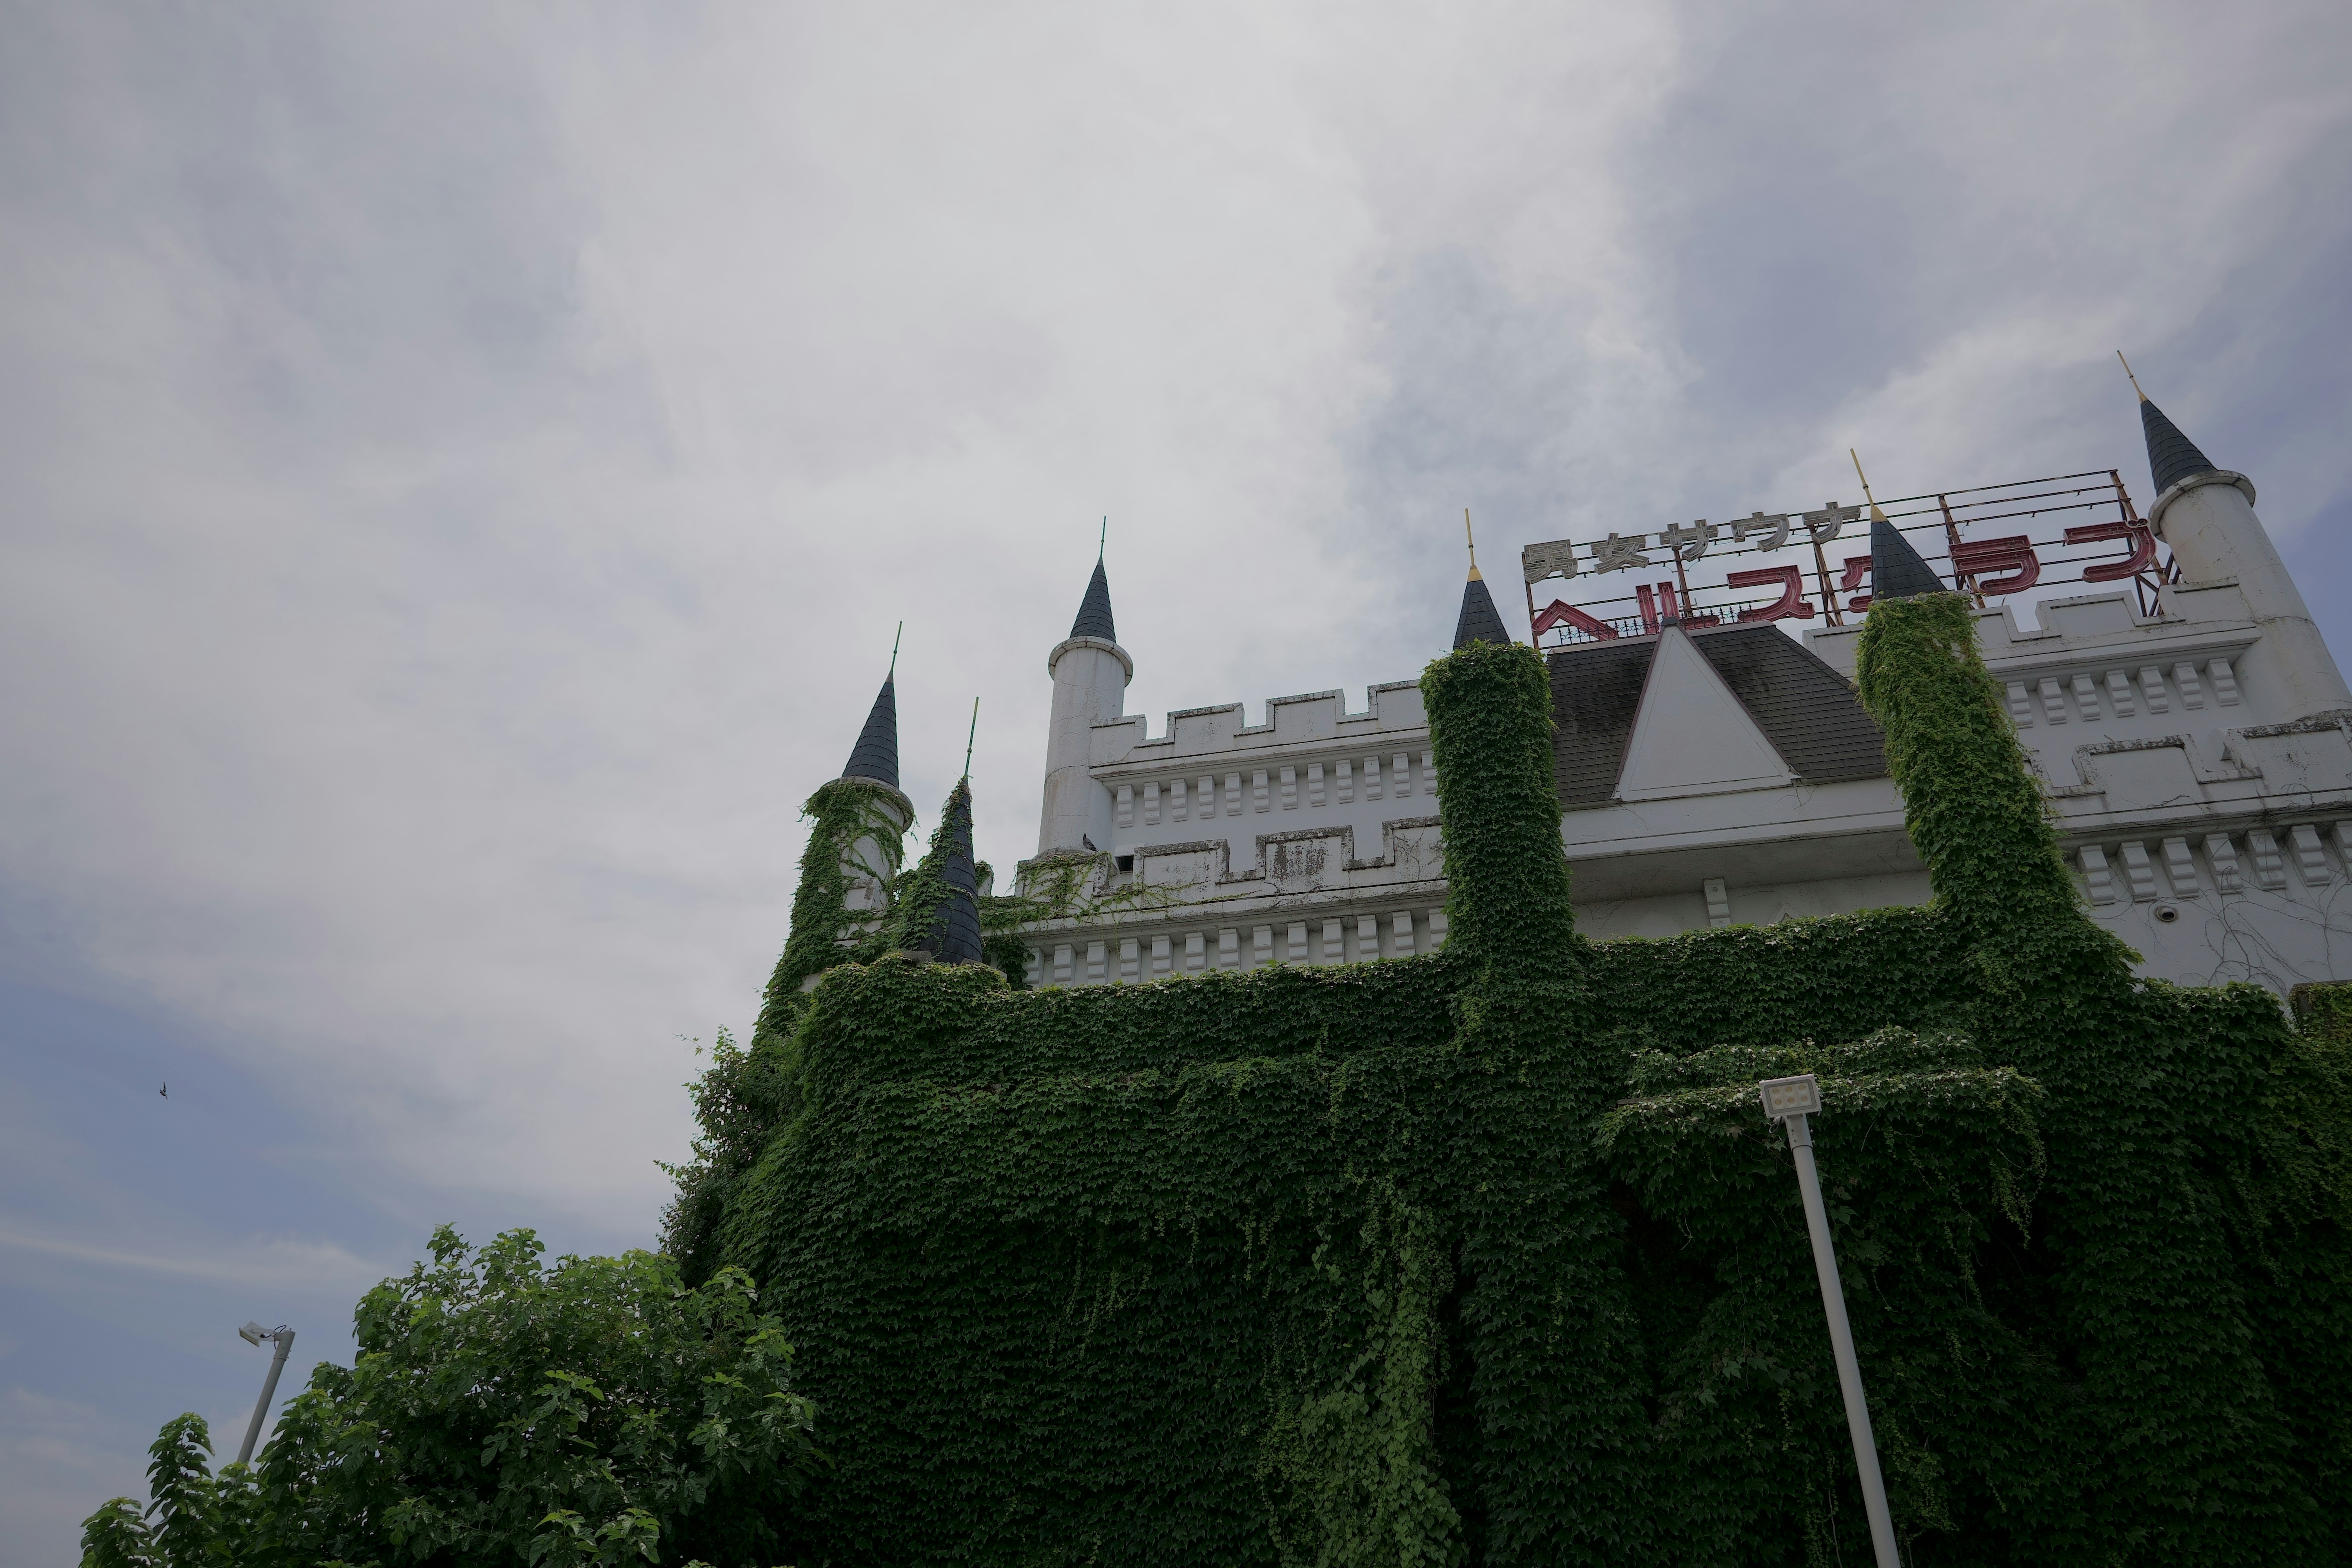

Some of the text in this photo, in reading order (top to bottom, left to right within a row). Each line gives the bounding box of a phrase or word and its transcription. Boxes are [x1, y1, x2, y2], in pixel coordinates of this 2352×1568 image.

[1523, 501, 1861, 584] 男女サウナ
